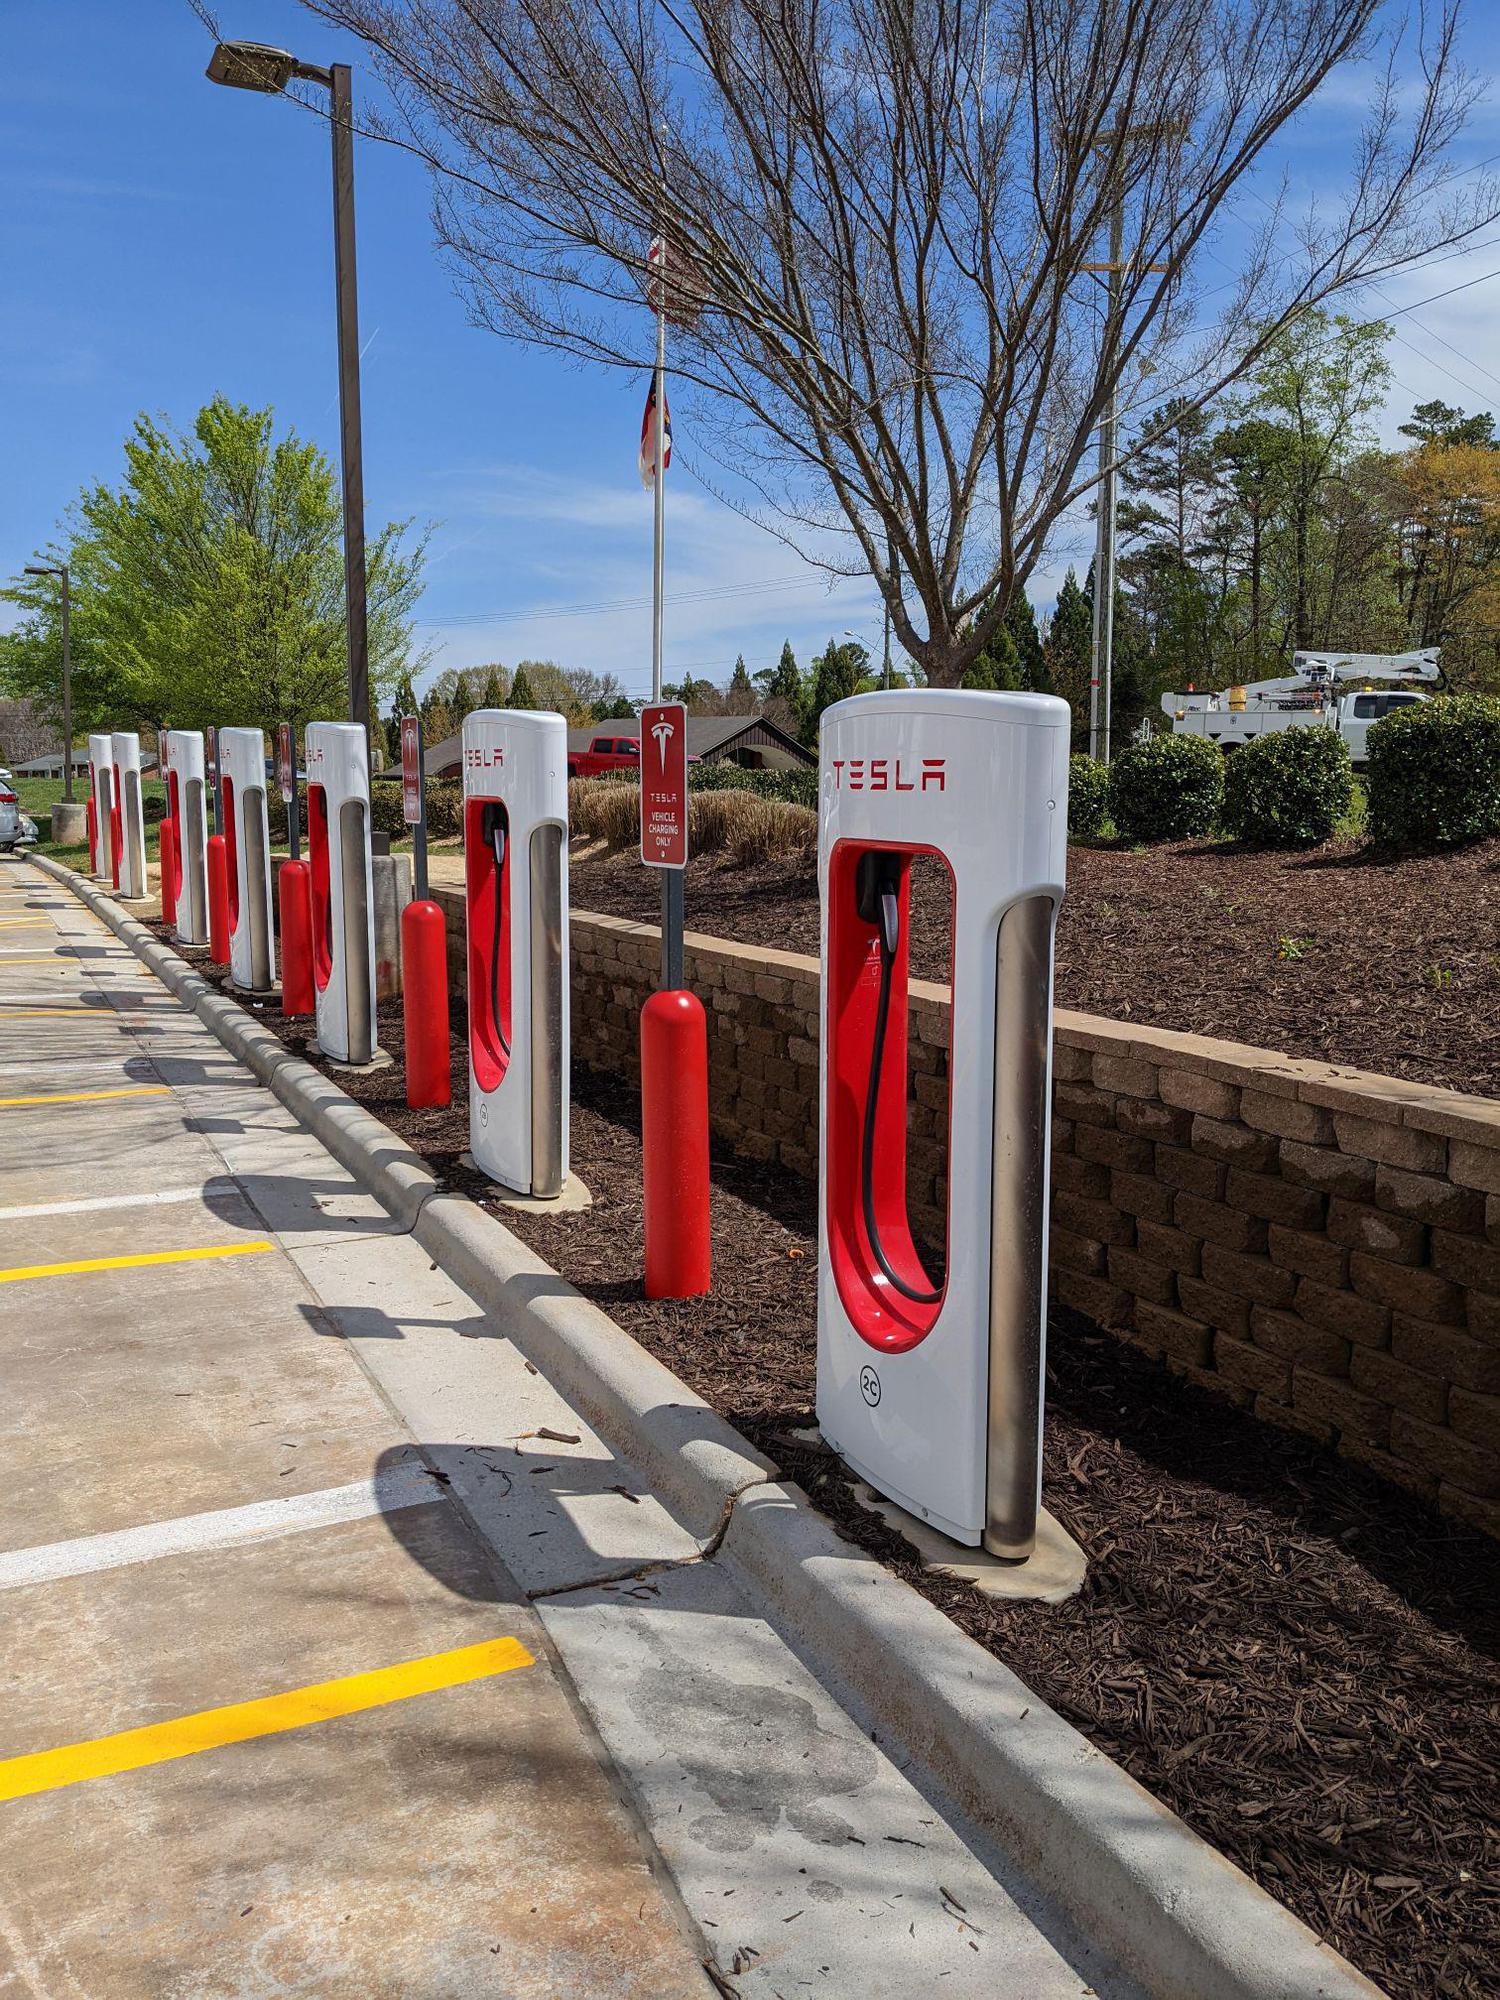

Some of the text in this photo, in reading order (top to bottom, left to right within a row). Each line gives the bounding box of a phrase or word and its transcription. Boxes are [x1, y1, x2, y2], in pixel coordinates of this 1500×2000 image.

[832, 760, 946, 791] TESLA
[650, 793, 677, 802] TESLA
[651, 811, 676, 822] VEHICLE
[649, 823, 679, 835] CHARGING
[656, 836, 672, 847] ONLY
[863, 1375, 877, 1396] 2C
